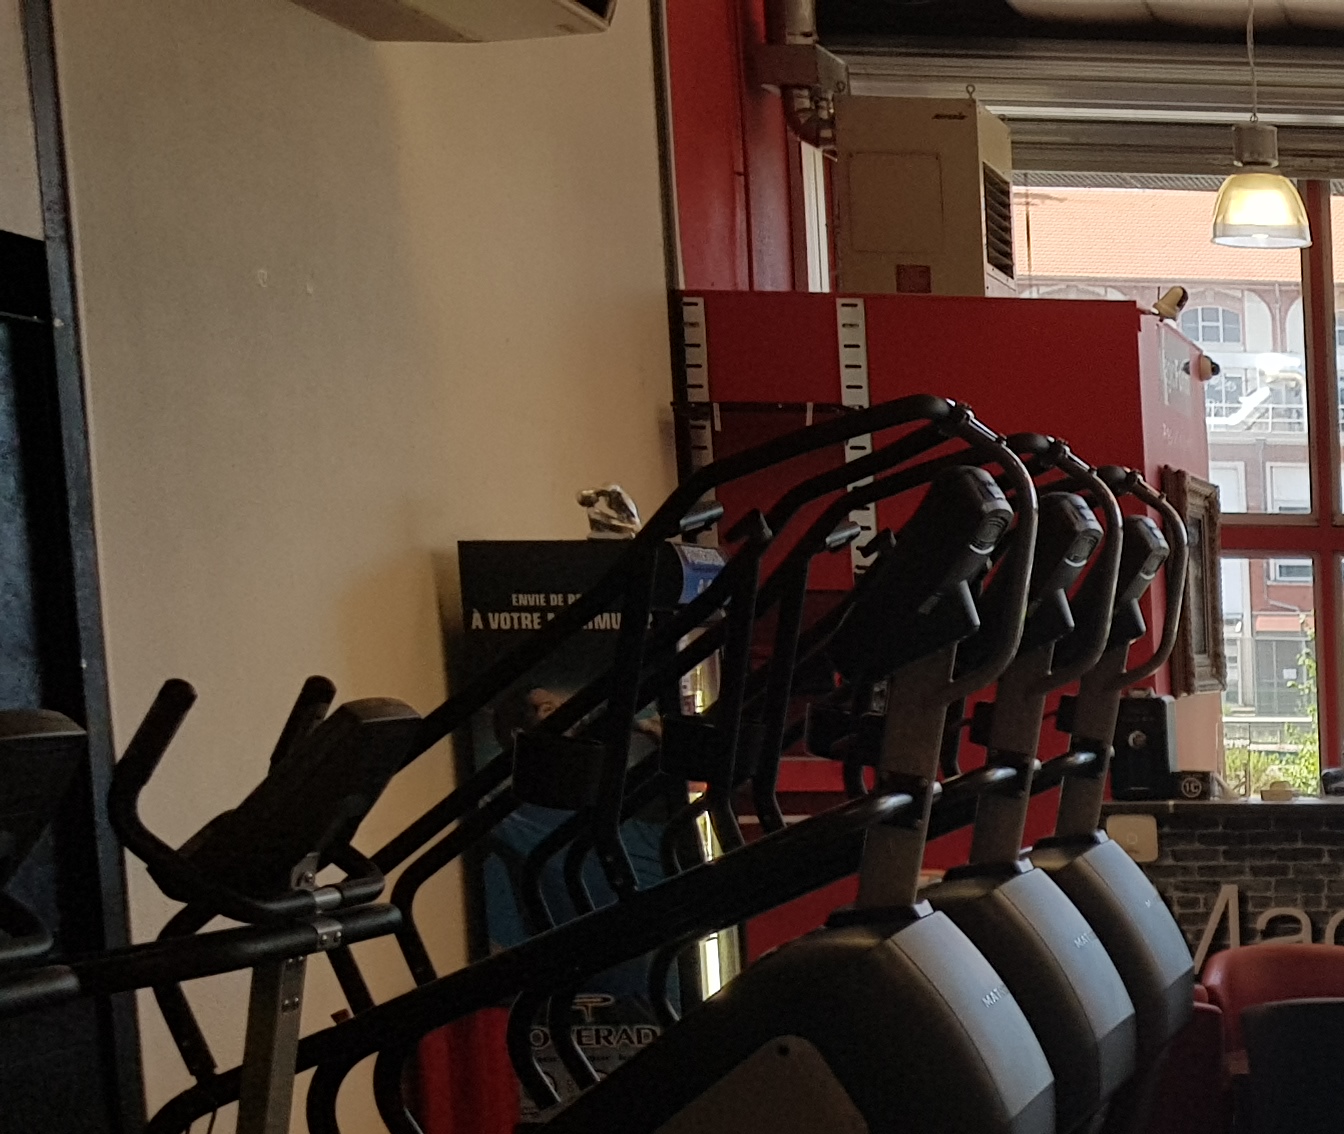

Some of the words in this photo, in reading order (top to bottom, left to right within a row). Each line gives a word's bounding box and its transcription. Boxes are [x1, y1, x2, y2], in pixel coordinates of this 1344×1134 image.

[511, 593, 547, 607] ENVIE
[549, 593, 565, 607] DE
[470, 607, 484, 630] À
[487, 611, 543, 630] VOTRE
[528, 1024, 662, 1049] OERAD
